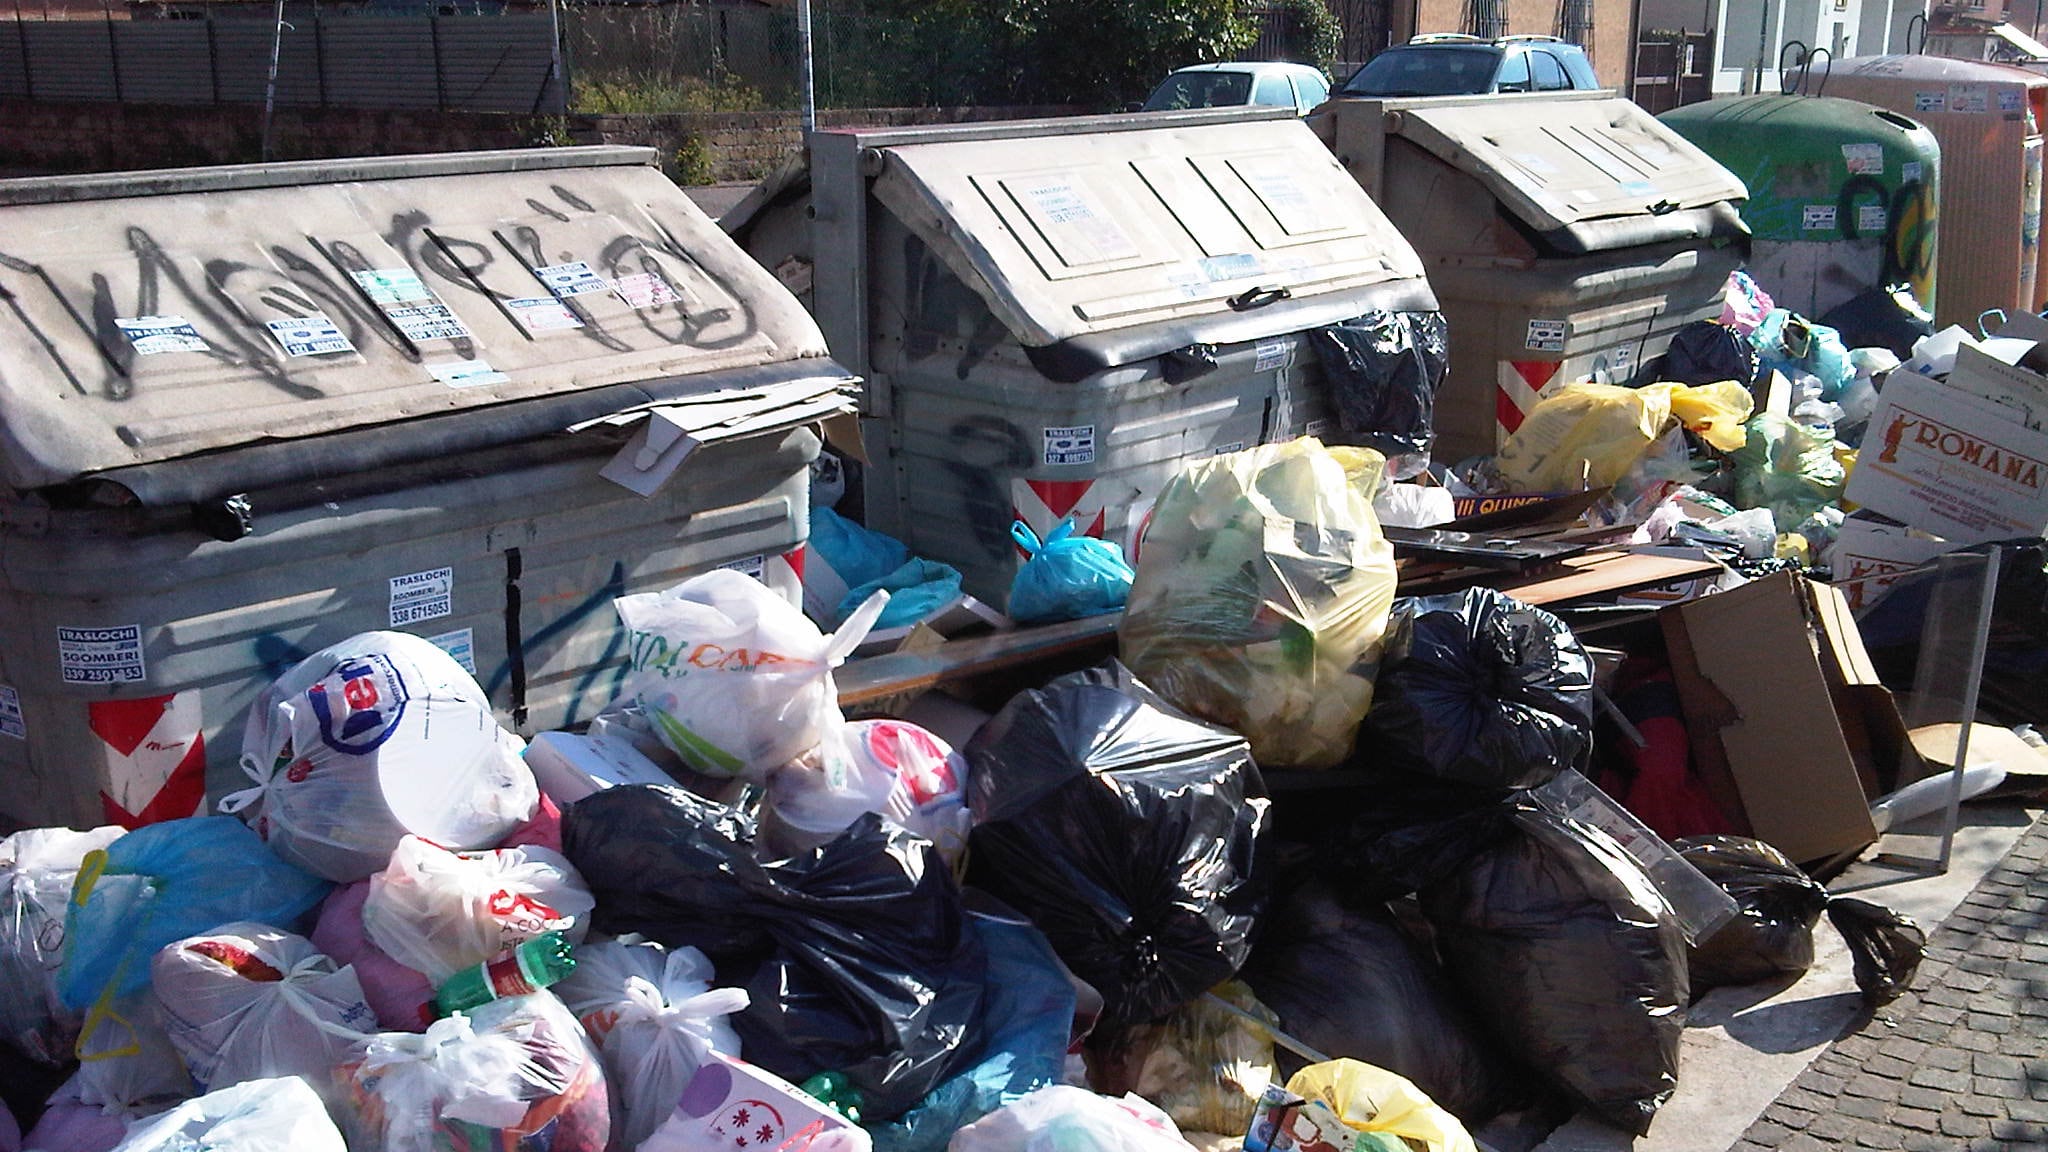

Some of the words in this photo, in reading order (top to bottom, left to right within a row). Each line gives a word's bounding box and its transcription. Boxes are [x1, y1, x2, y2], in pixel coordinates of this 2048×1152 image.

[1915, 421, 2038, 489] ROMANA
[393, 569, 450, 587] TRASLOCHI
[392, 609, 409, 624] 338
[411, 601, 449, 620] 6715053
[61, 628, 136, 641] TRASLOCHI
[63, 651, 139, 663] SGOMBERI
[65, 668, 85, 680] 339
[88, 667, 141, 681] 250153
